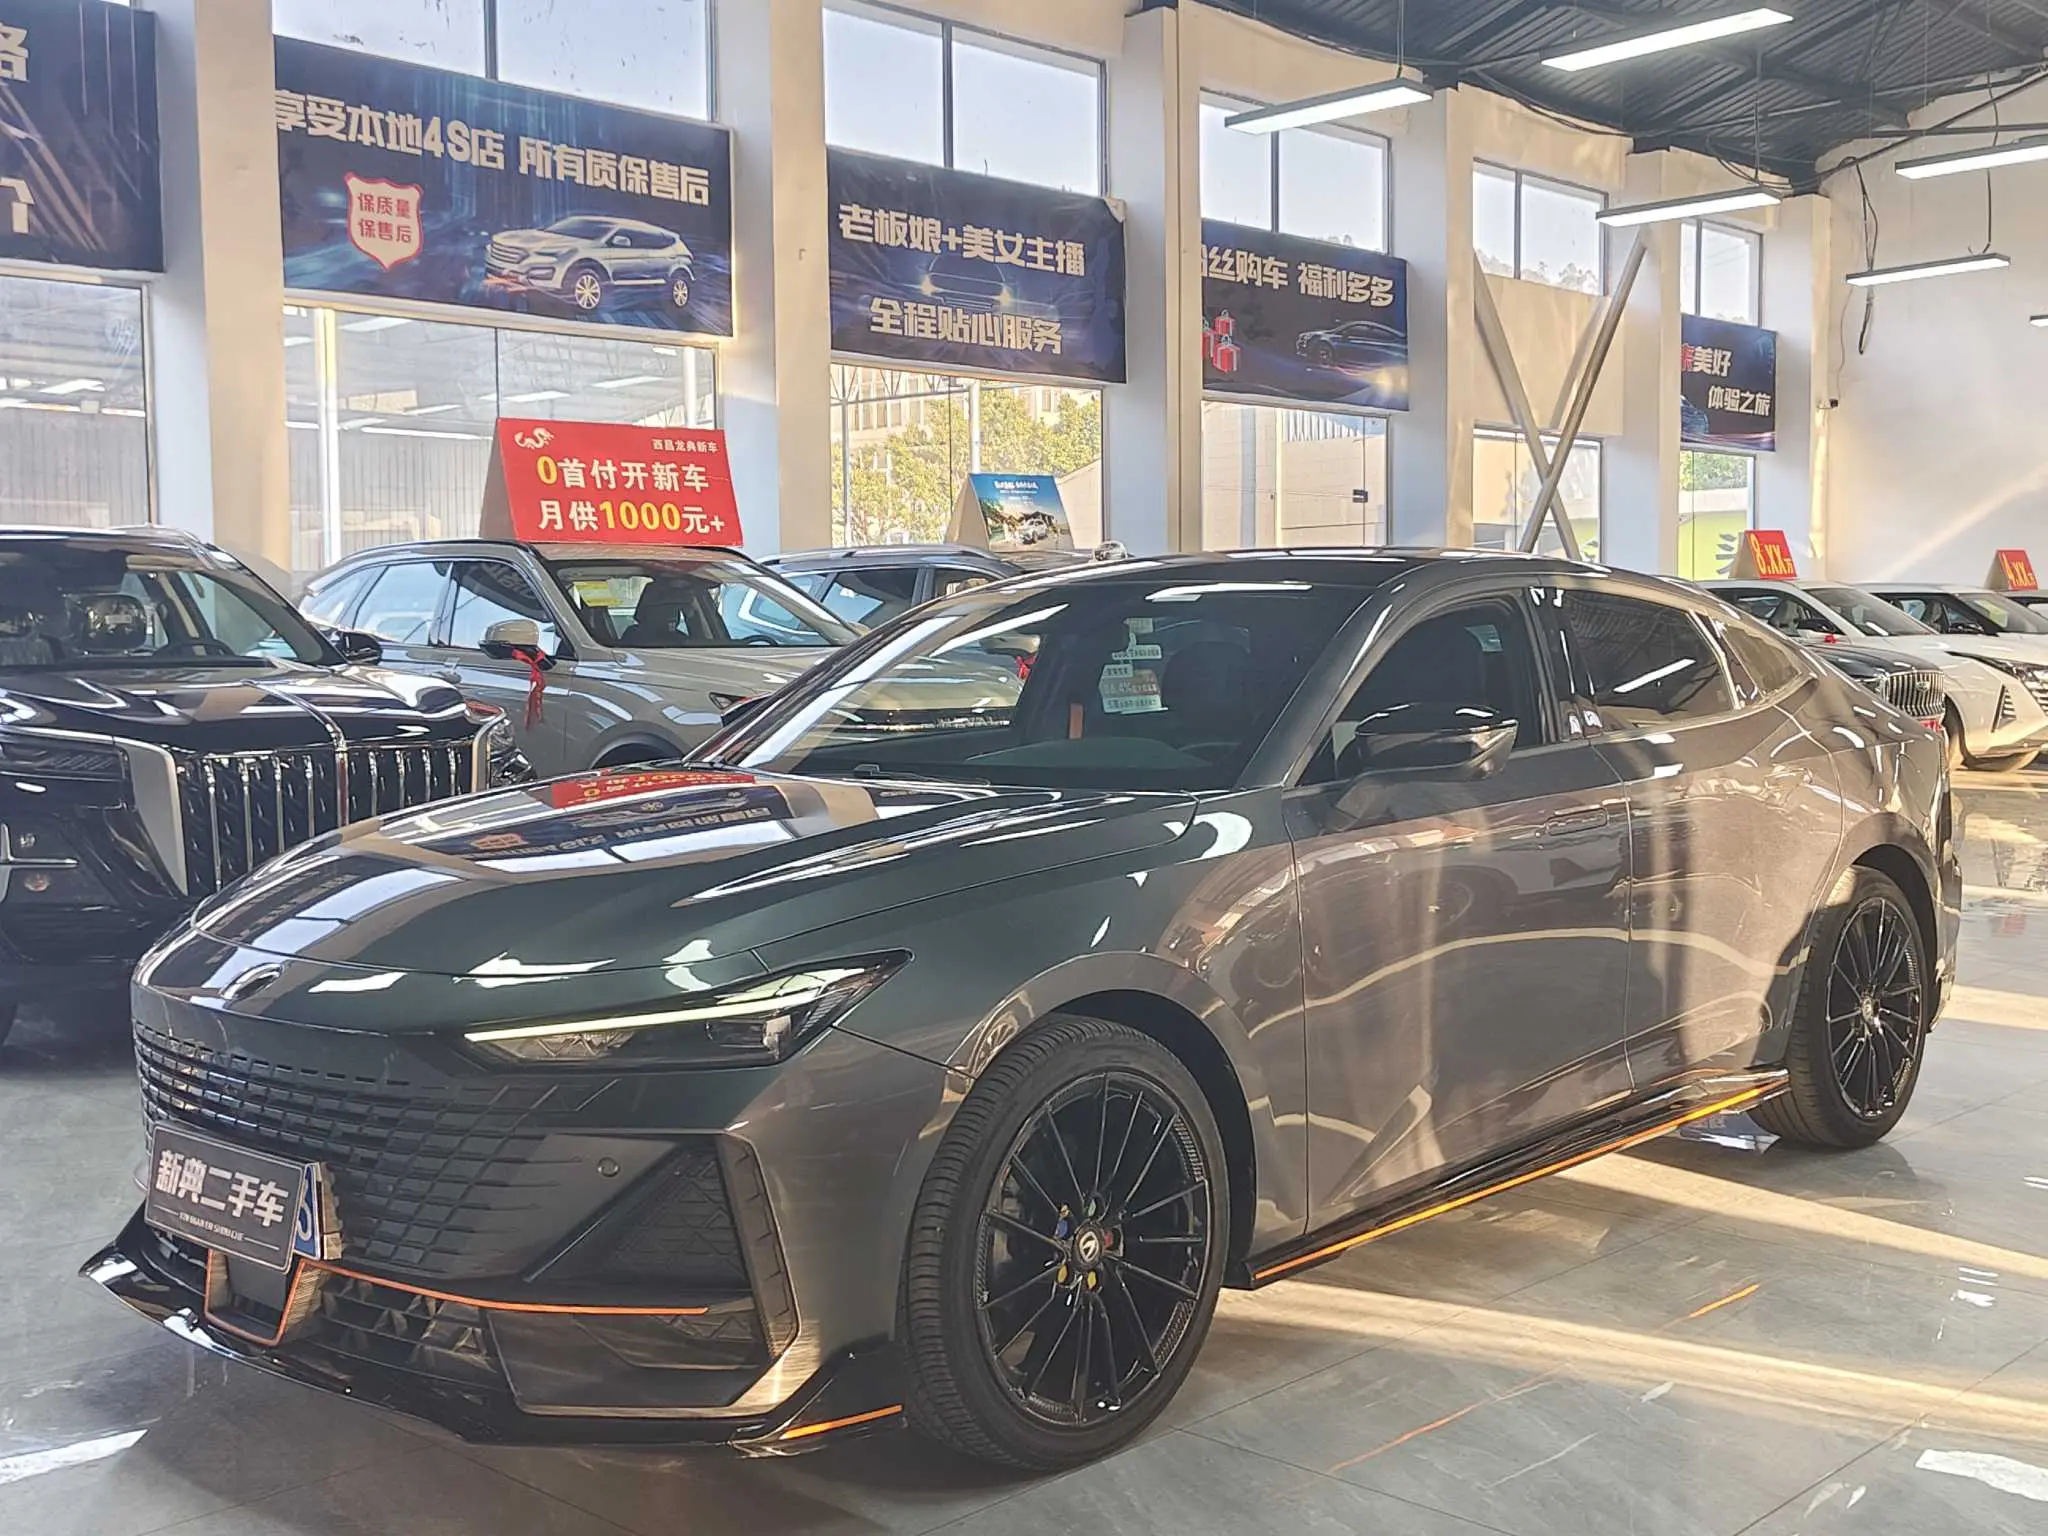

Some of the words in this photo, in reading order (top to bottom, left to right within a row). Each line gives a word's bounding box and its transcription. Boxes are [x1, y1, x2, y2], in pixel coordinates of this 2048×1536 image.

[275, 89, 505, 170] 享受本地4S店
[519, 136, 710, 206] 所有质保售后
[357, 193, 411, 219] 保质量
[357, 219, 412, 243] 保售后
[838, 203, 1085, 277] 老板娘+美女主播
[1200, 243, 1288, 289] 丝购车
[1298, 262, 1394, 307] 福利多多
[869, 297, 1062, 354] 全程贴心服务
[1708, 385, 1772, 416] 体验之旅
[536, 455, 709, 492] 0首付开新车
[538, 500, 725, 534] 月供1000元+
[155, 1149, 289, 1227] 新典二手车
